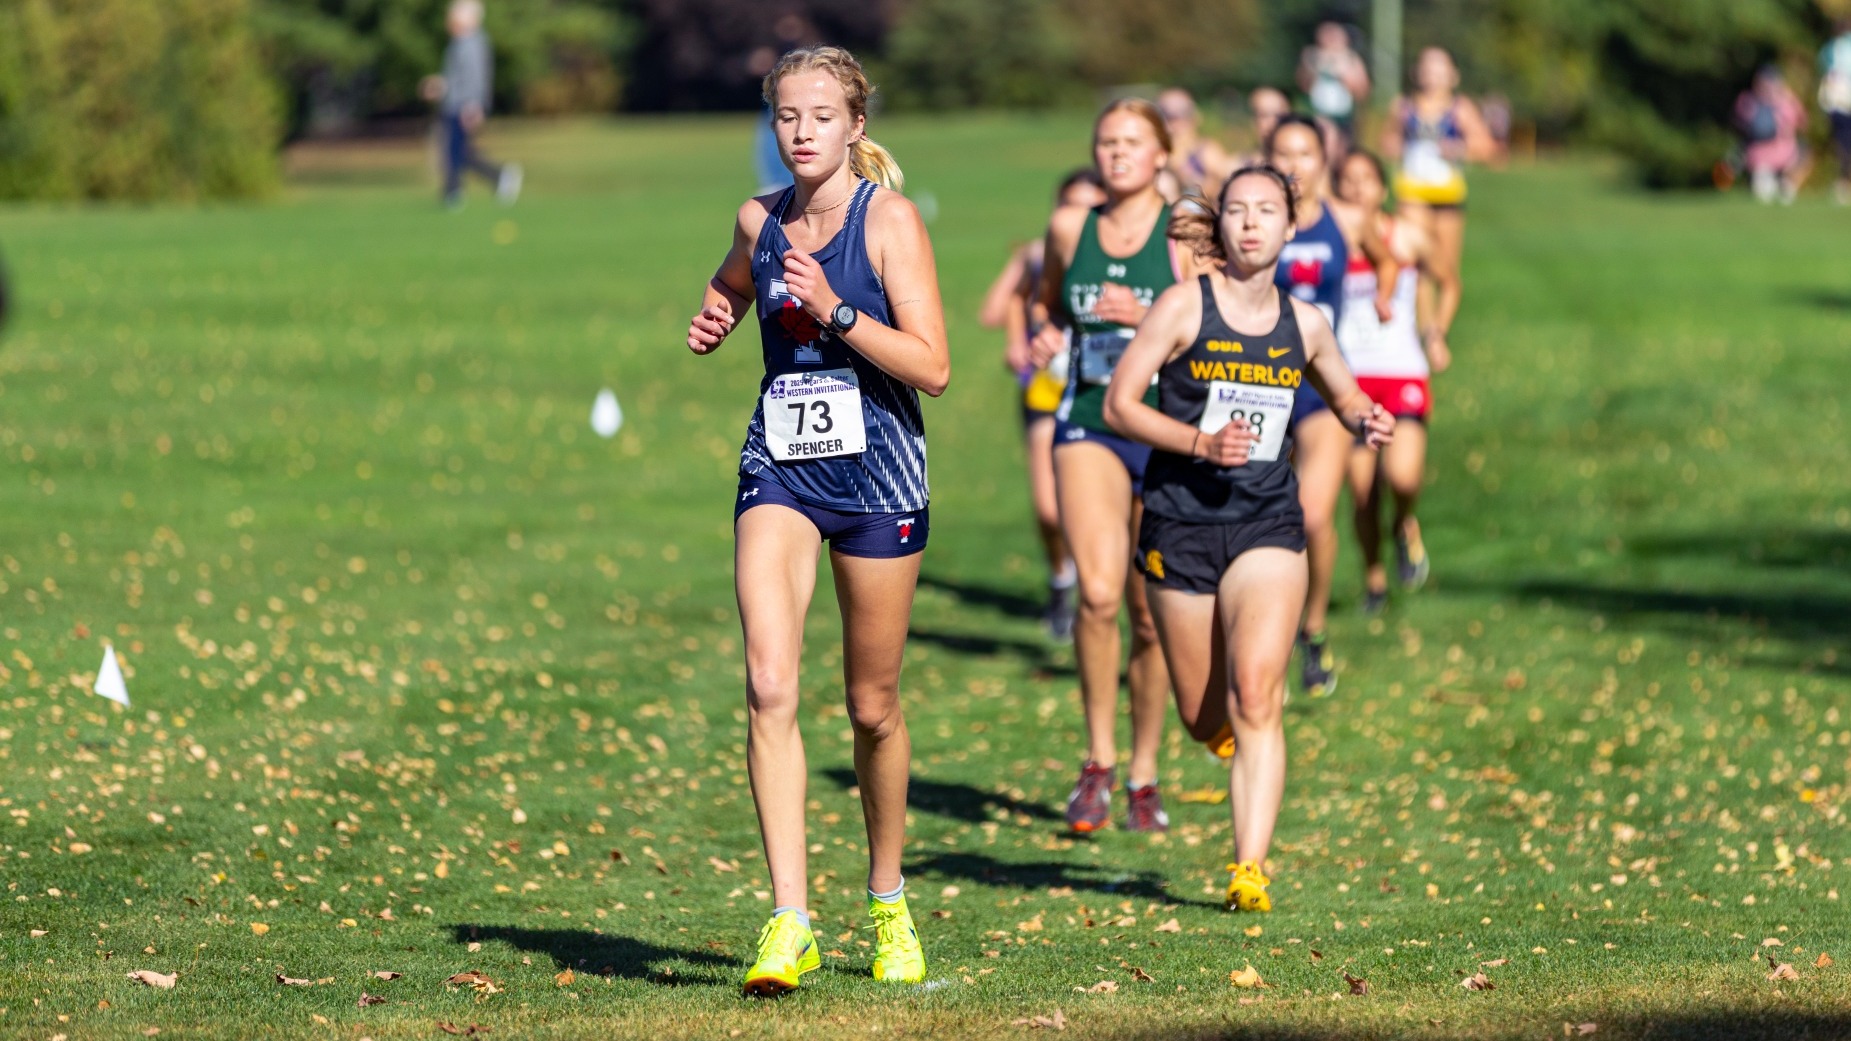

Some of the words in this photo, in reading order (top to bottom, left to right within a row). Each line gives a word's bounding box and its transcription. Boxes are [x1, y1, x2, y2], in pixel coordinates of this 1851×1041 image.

[1206, 340, 1244, 353] OUA
[1190, 360, 1302, 388] WATERLOO
[786, 387, 813, 397] WESTERN
[814, 382, 856, 395] INVITATIONAL
[787, 400, 834, 436] 73
[787, 438, 844, 457] SPENCER
